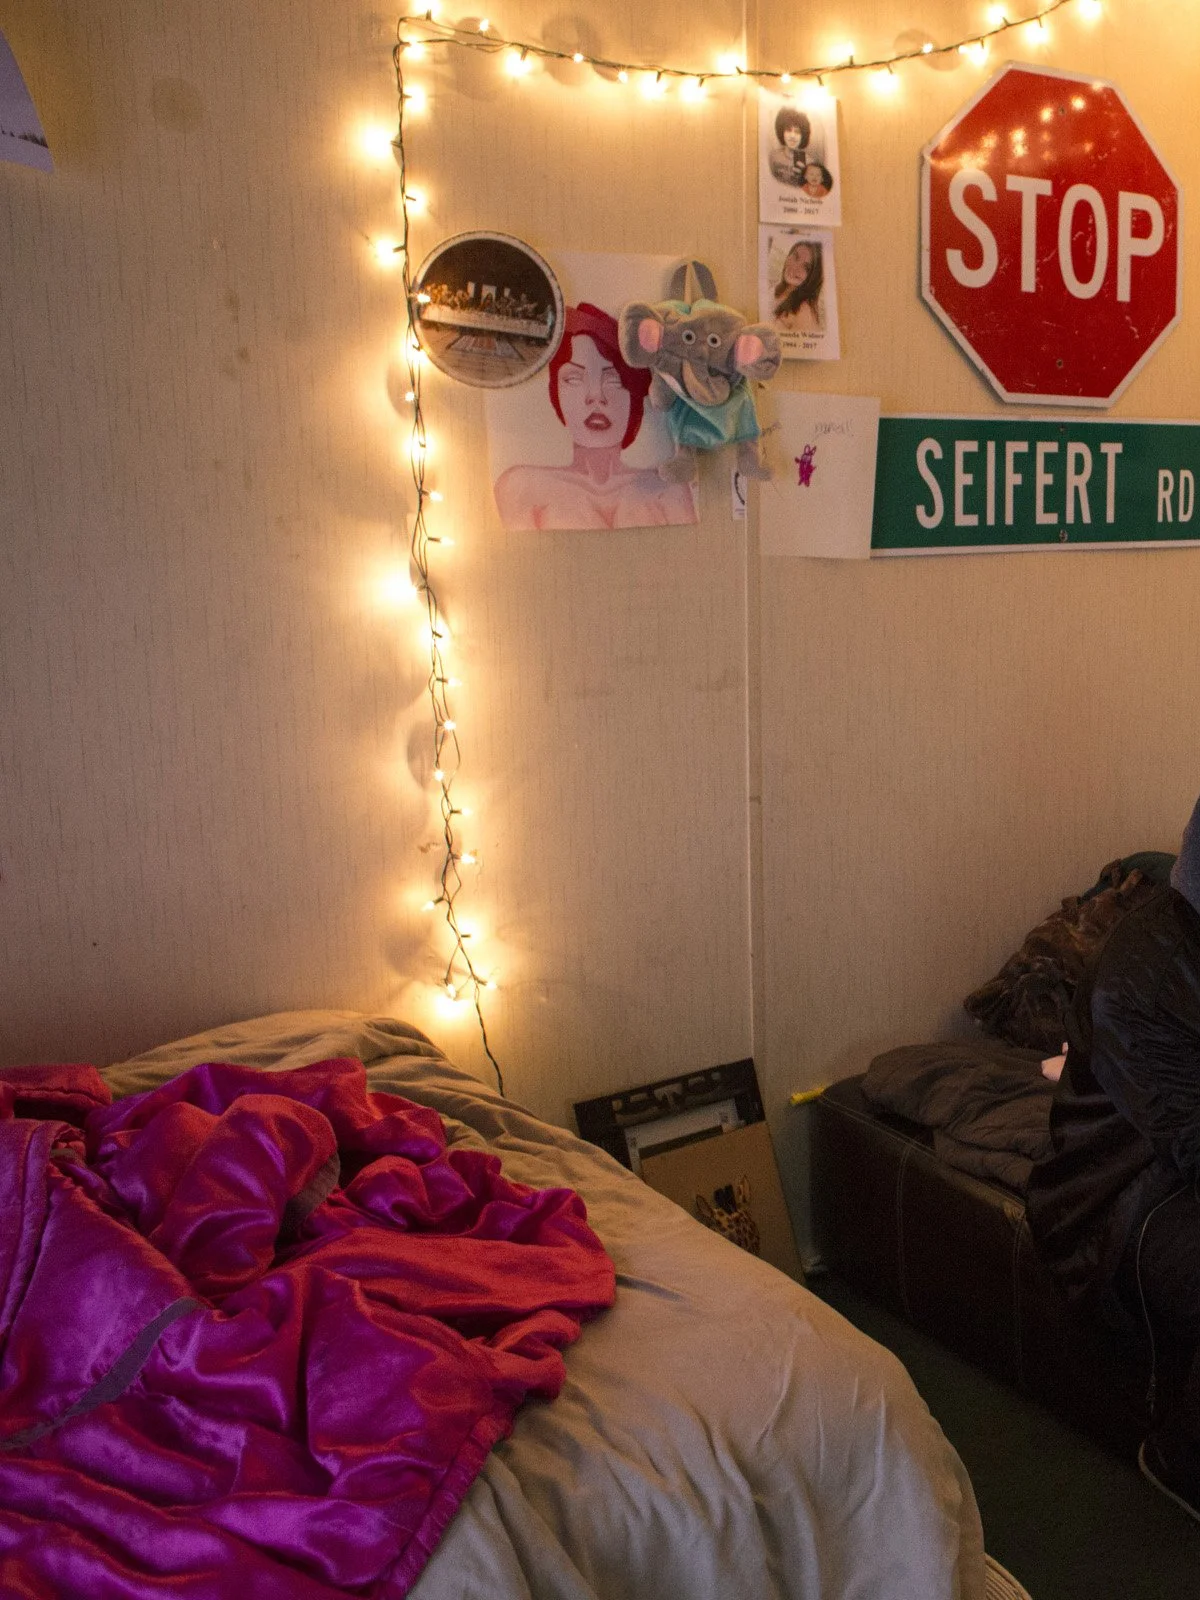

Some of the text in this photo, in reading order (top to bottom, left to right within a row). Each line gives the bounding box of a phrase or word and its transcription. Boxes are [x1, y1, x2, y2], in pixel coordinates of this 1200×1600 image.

[946, 168, 1165, 303] STOP
[915, 436, 1196, 529] SEIFERT RD
